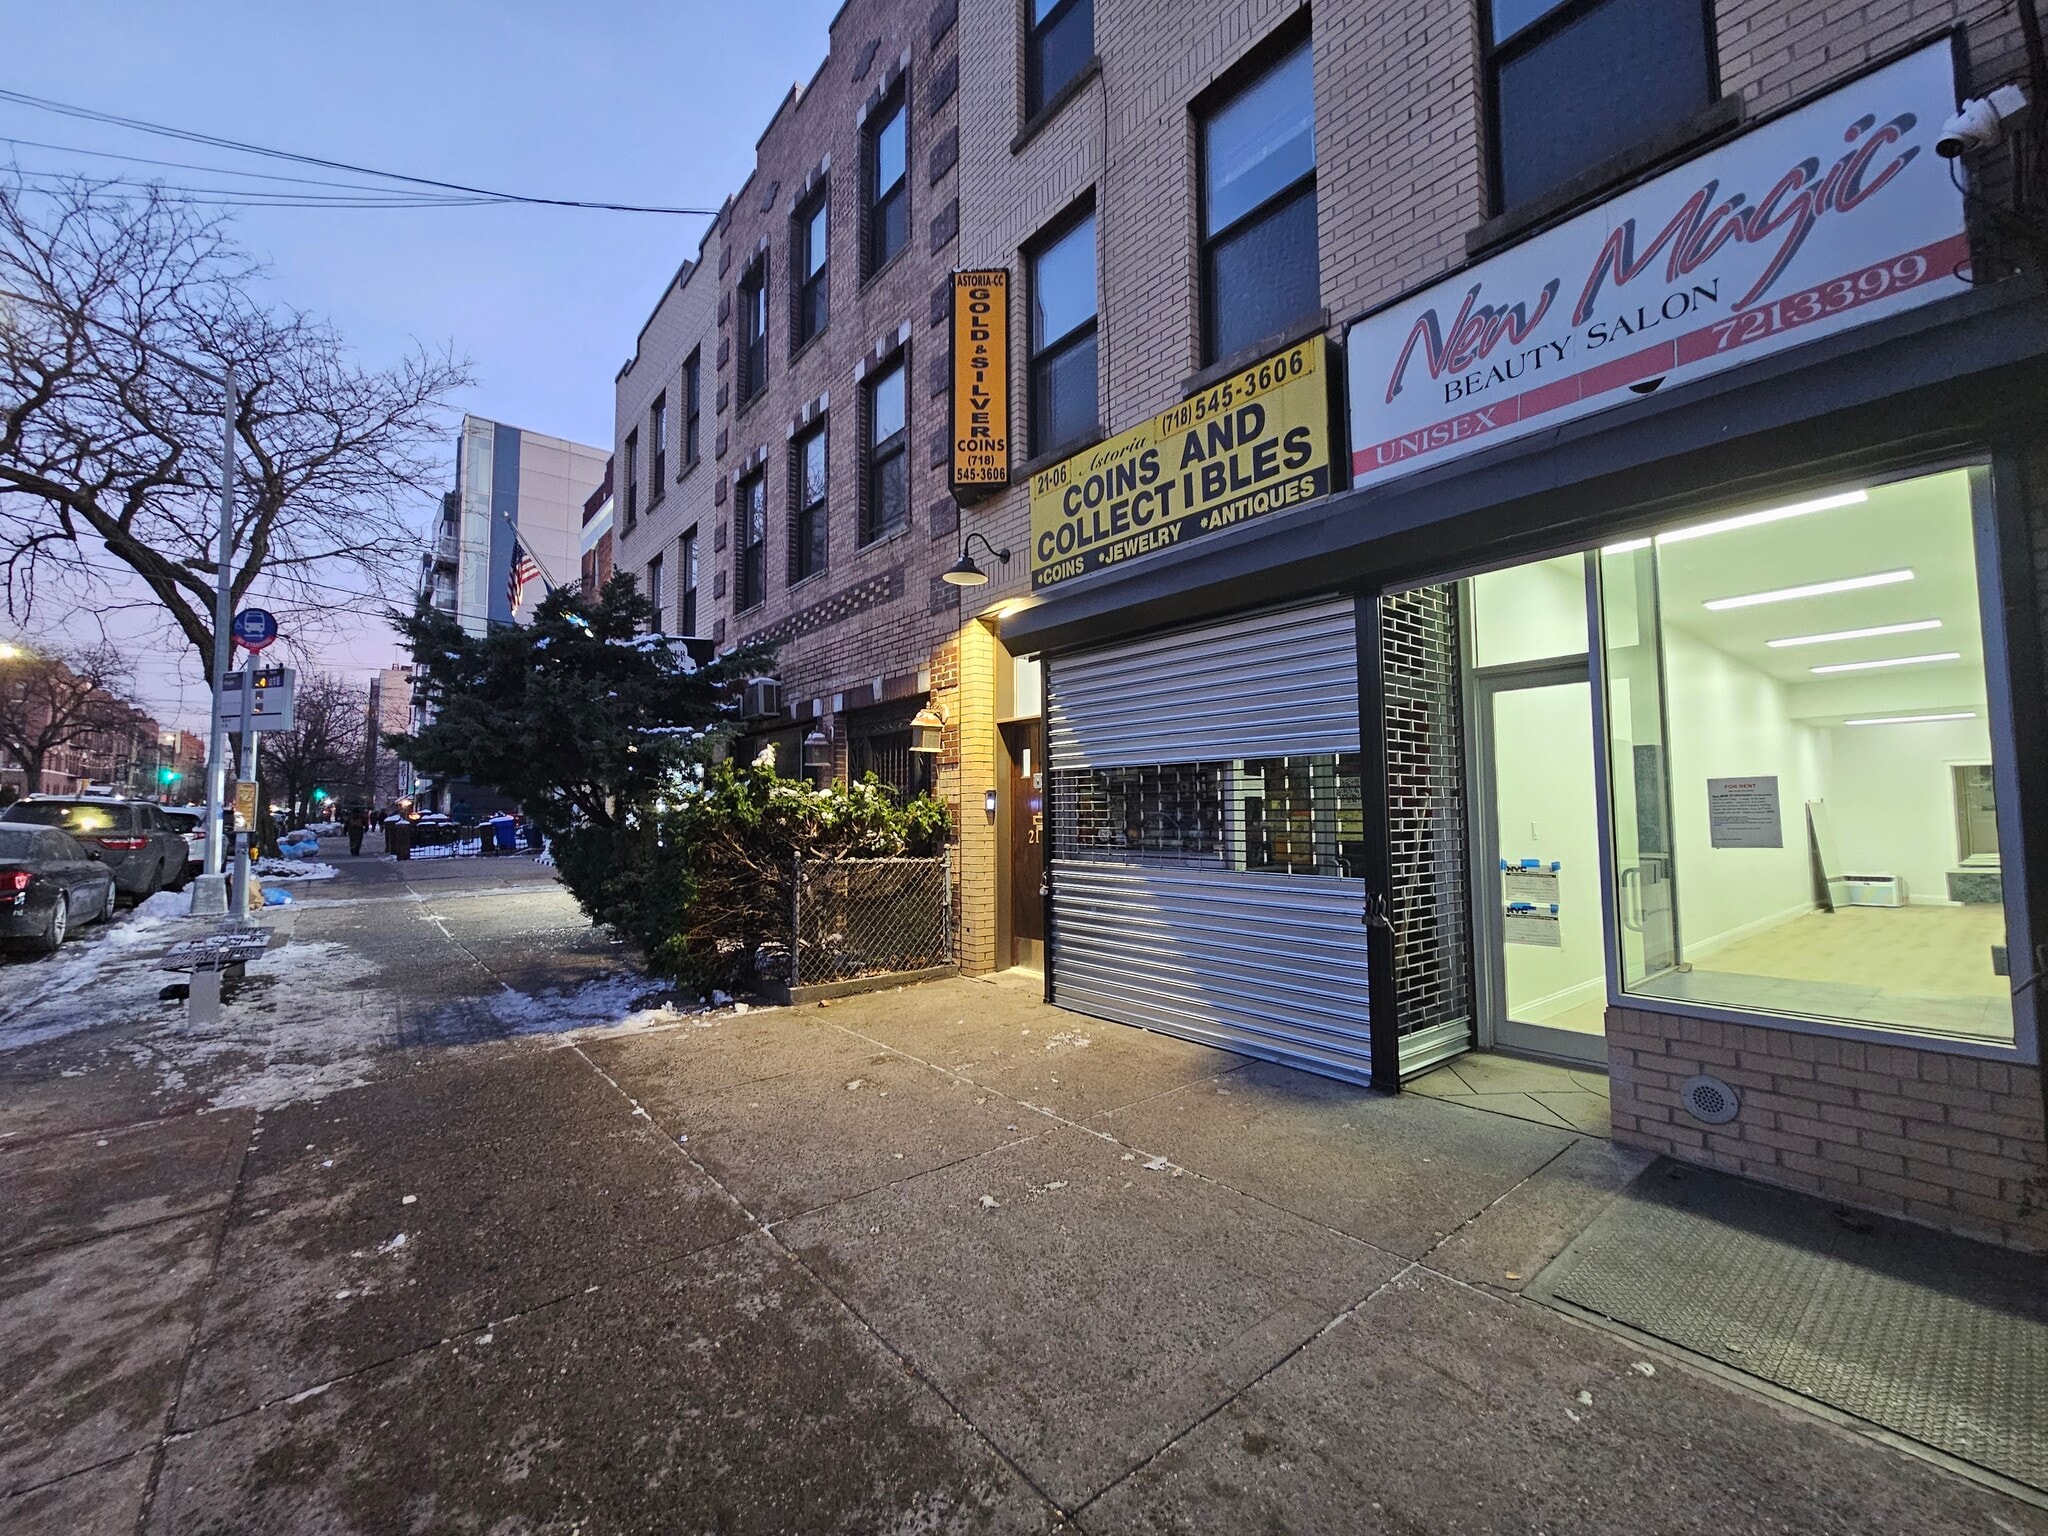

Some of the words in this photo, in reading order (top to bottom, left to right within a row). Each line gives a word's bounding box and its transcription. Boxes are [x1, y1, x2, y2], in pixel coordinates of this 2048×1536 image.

[1386, 277, 1561, 404] New
[1572, 112, 1921, 327] Magic
[1711, 253, 1927, 353] 721-3399
[1444, 335, 1572, 404] BEAUTY
[1586, 278, 1720, 350] SALON
[1162, 403, 1192, 436] (718)
[1195, 350, 1303, 420] 545-3606
[957, 439, 1005, 451] COINS
[967, 455, 995, 467] (718)
[1063, 448, 1160, 517] COINS
[1180, 402, 1266, 471] AND
[1079, 436, 1147, 477] Astoria
[1375, 407, 1501, 466] UNISEX
[957, 467, 1006, 481] 545-3606
[1037, 465, 1067, 495] 21-06
